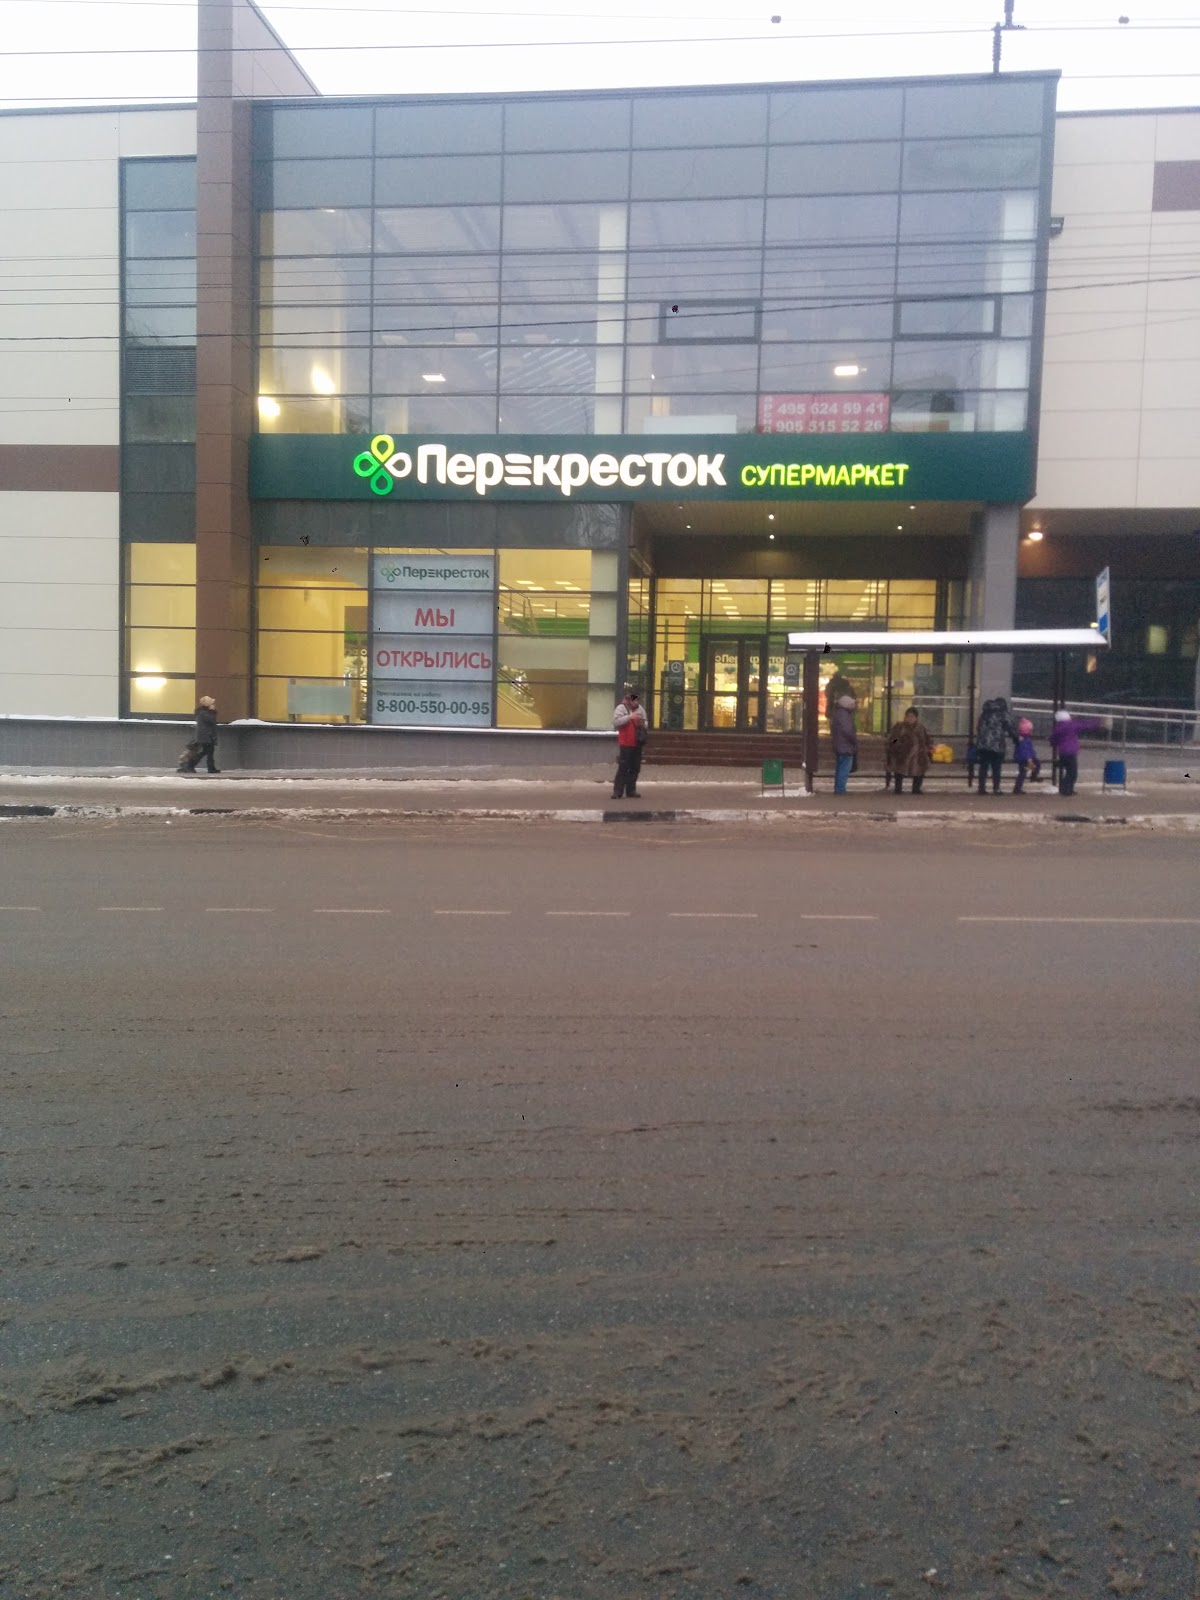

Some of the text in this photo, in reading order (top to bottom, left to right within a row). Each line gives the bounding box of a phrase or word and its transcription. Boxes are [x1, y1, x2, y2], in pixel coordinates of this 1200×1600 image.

[778, 402, 884, 415] 495 624 59 41
[776, 420, 883, 433] 905 515 52 26
[417, 443, 909, 496] Перекресток СУПЕРМАРКЕТ
[402, 566, 490, 581] Перекресток
[414, 608, 455, 627] МЫ
[376, 650, 492, 669] ОТКРЫЛИСЬ
[376, 699, 490, 715] 8-800-550-00-95
